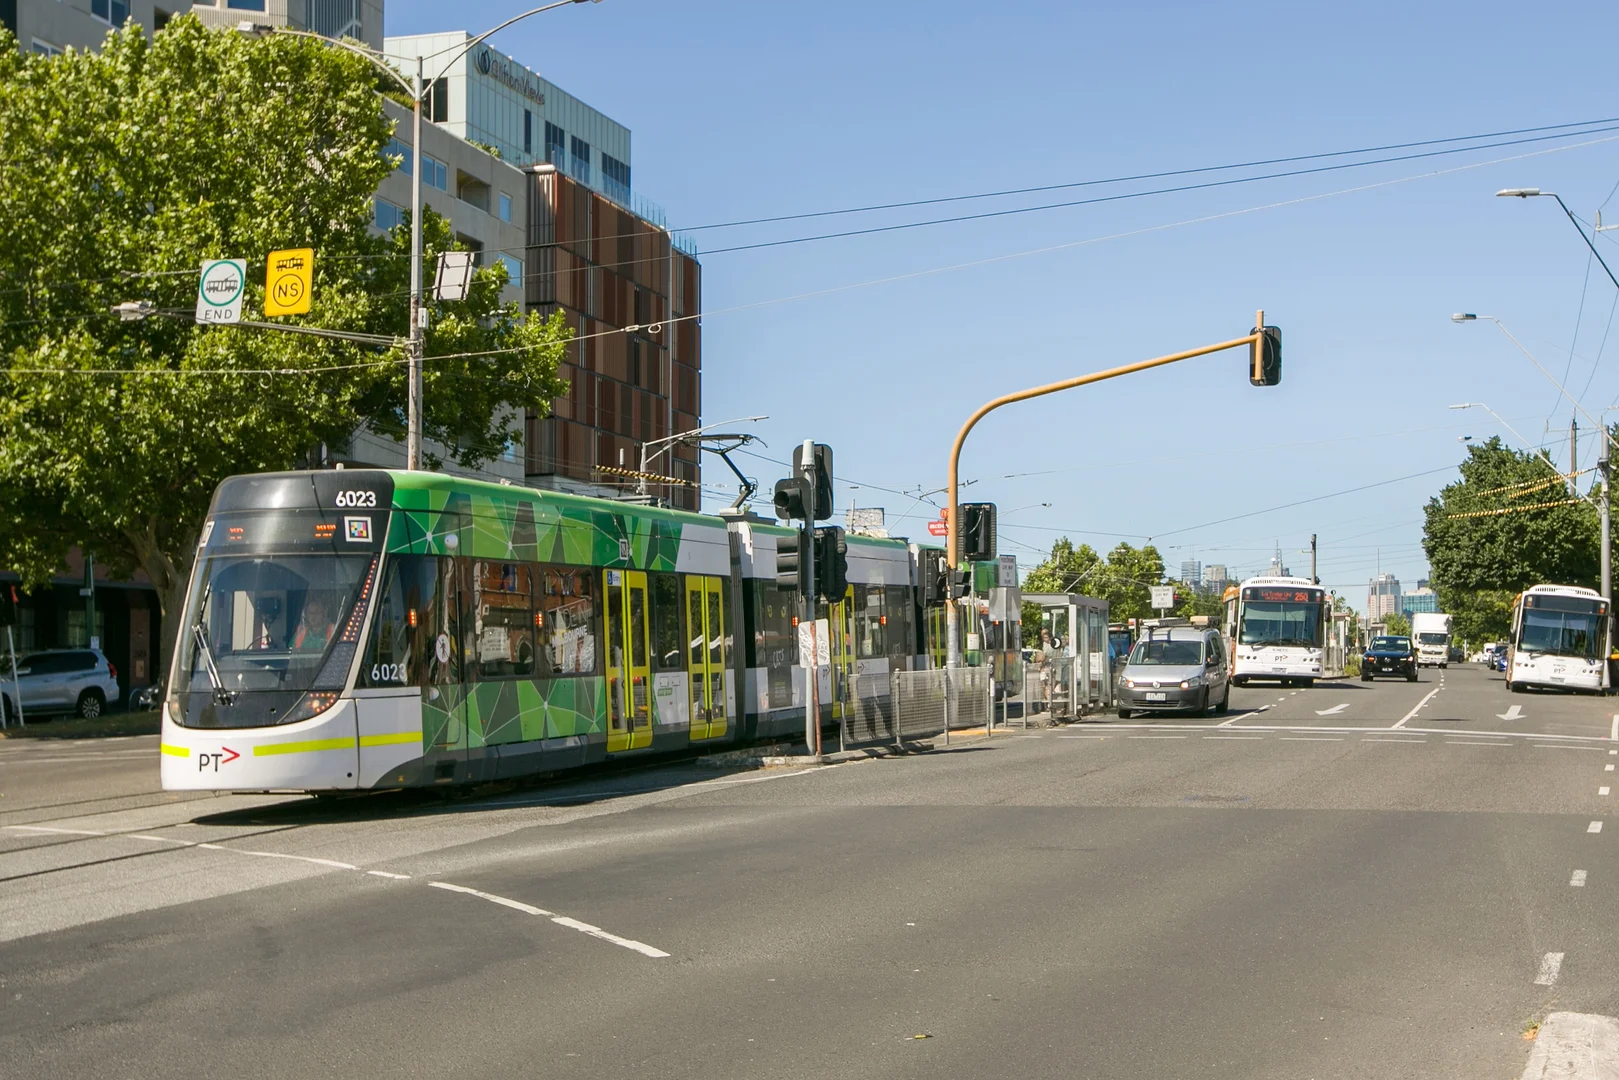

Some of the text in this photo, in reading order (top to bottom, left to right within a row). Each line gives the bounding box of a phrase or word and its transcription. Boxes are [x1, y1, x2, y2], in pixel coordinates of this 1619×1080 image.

[278, 283, 299, 298] NS
[205, 309, 232, 320] END
[335, 491, 376, 507] 6023
[1294, 592, 1308, 602] 250
[371, 663, 406, 681] 6023
